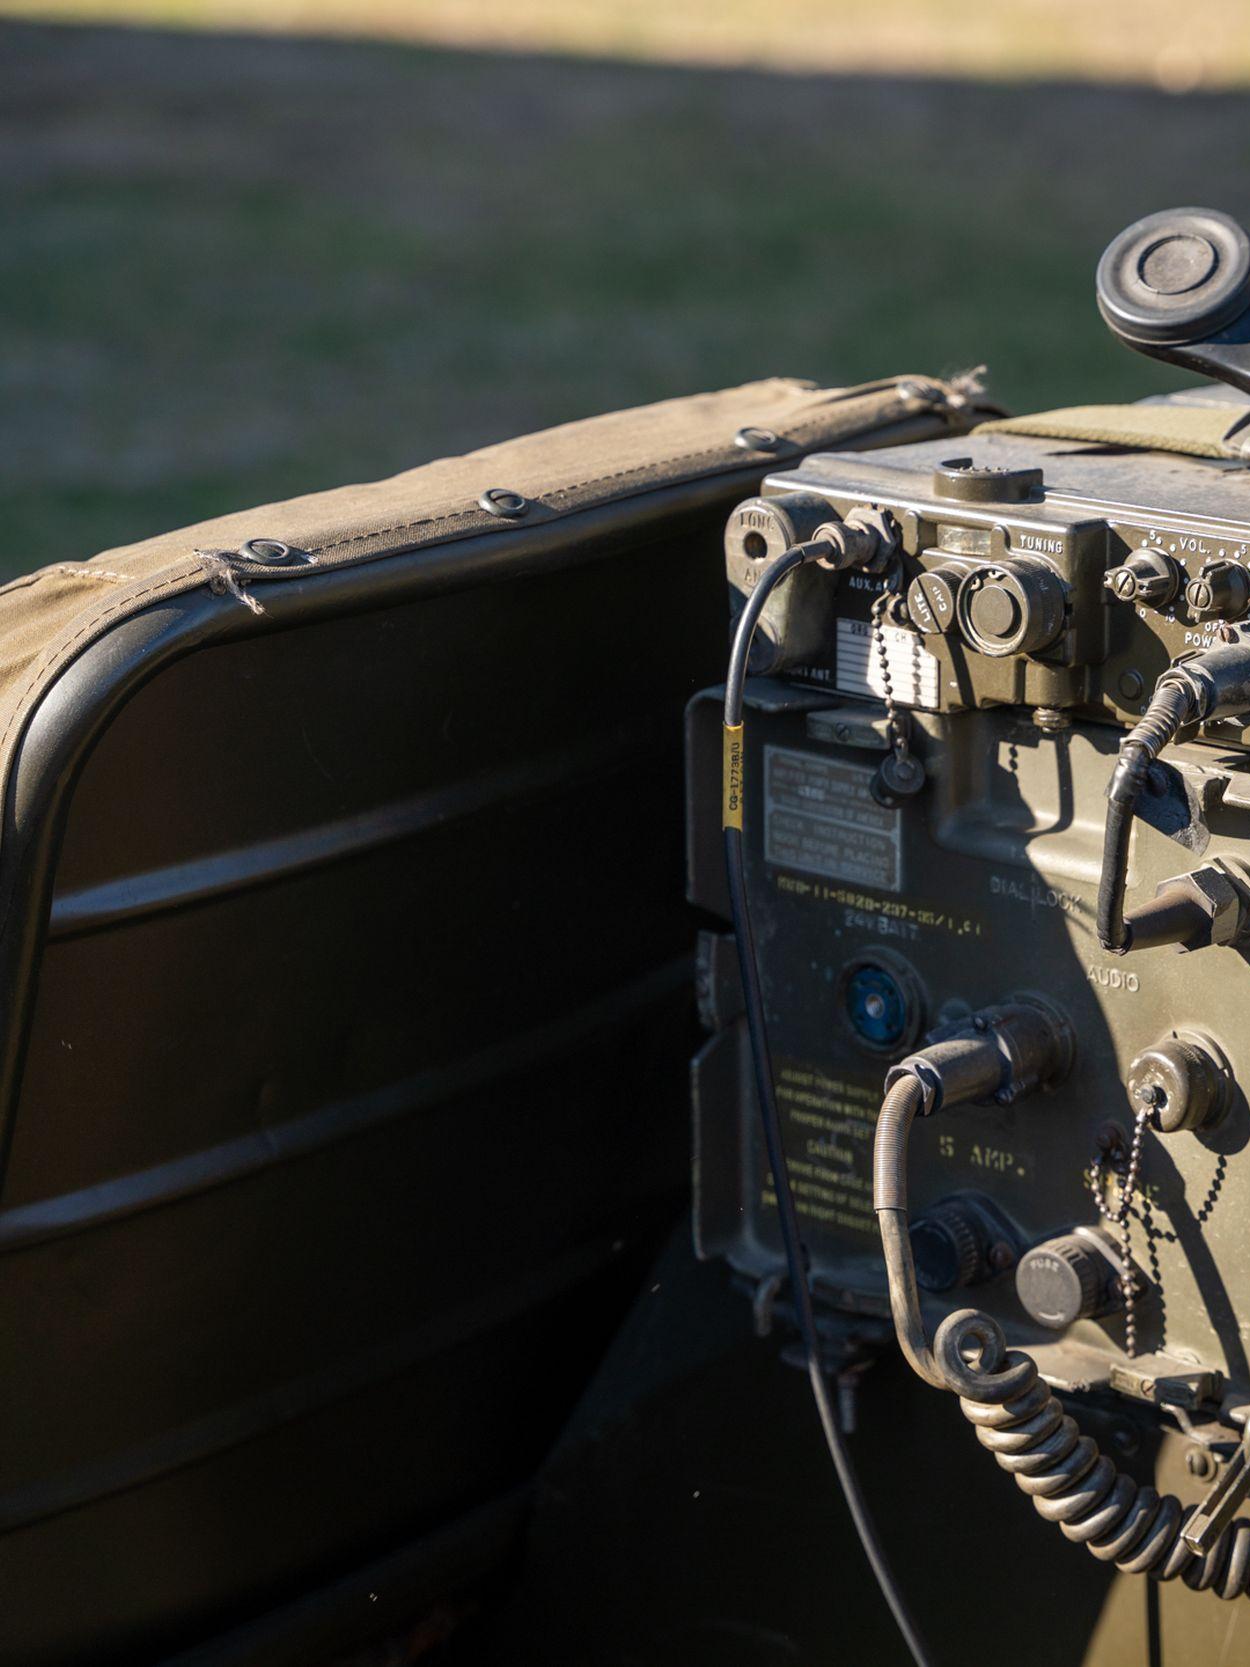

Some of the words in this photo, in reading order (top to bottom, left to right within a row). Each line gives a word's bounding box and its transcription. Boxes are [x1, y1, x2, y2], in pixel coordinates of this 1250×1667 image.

[1019, 534, 1064, 554] TUNING
[1149, 530, 1156, 540] 5
[1179, 537, 1211, 555] VOL.
[1241, 544, 1249, 555] 5
[744, 567, 761, 584] AN
[914, 592, 931, 623] LITE
[1184, 631, 1216, 647] POW
[728, 742, 740, 811] CG-1773B/U
[989, 875, 1029, 900] DIAL
[1086, 964, 1140, 992] AUDIO
[940, 1135, 954, 1156] 5
